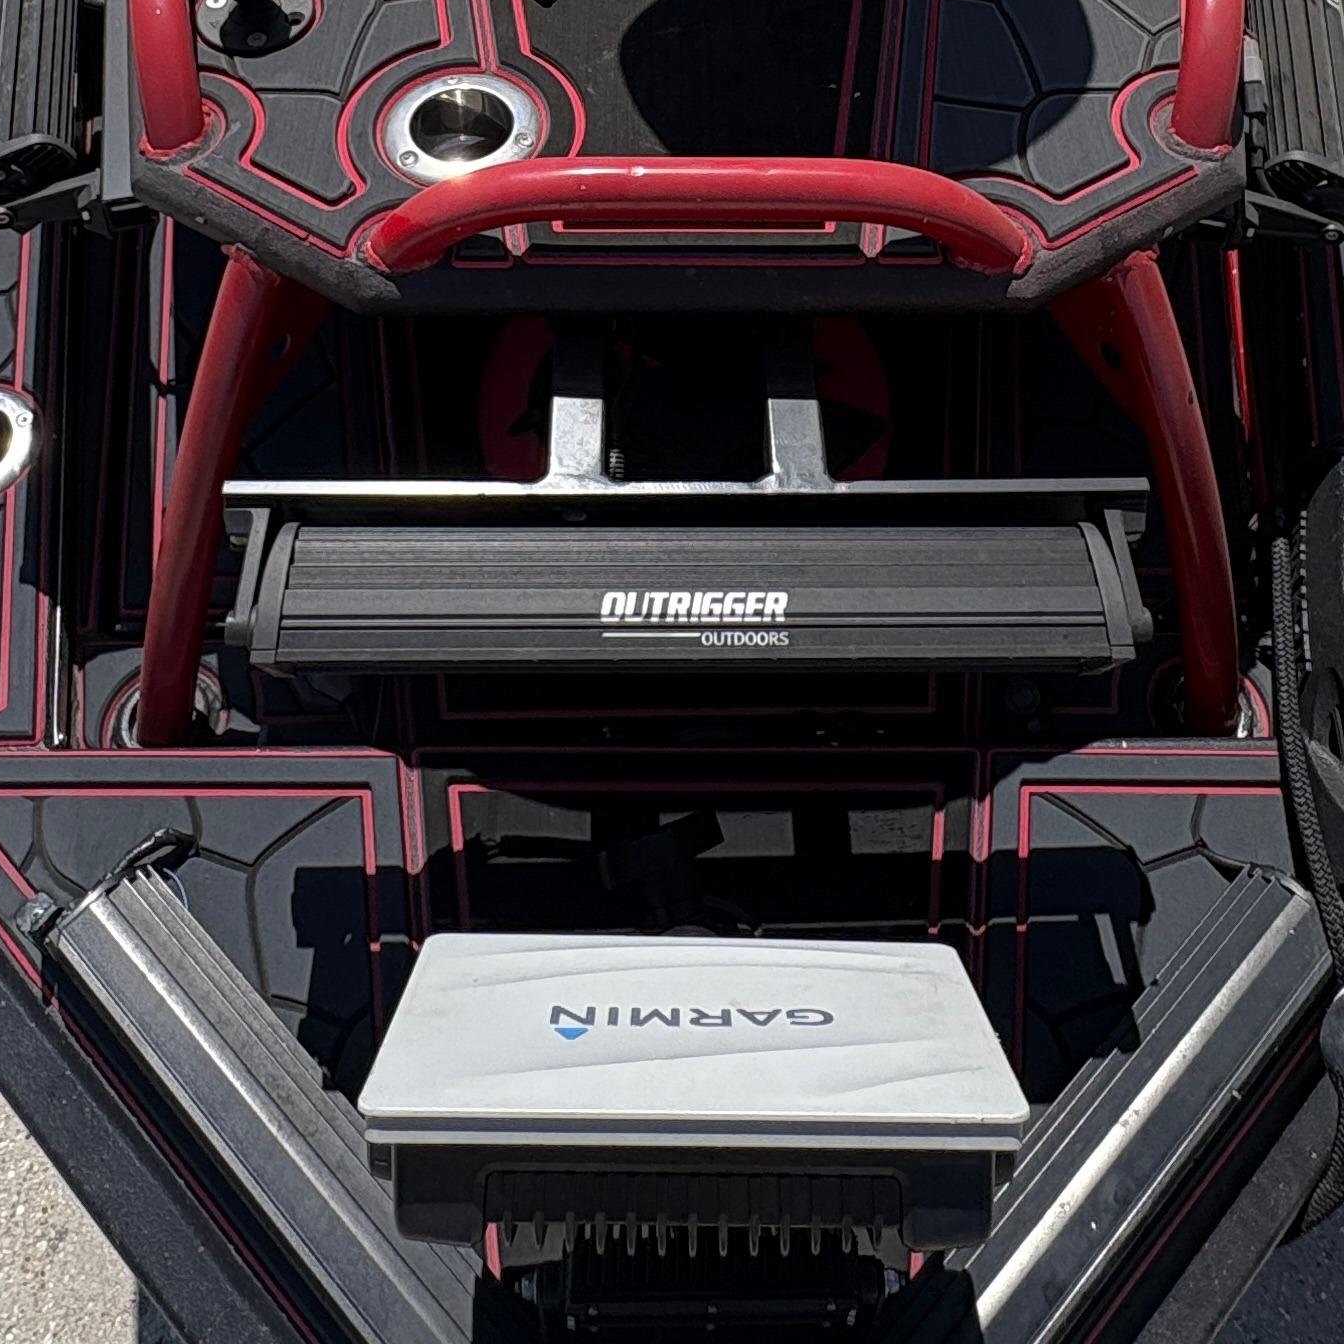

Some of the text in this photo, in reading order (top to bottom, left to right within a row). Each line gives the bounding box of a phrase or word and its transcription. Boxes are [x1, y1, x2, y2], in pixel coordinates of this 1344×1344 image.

[601, 591, 789, 623] OUTRIGGER
[700, 631, 790, 646] OUTDOORS
[549, 1005, 834, 1027] GARMIN
